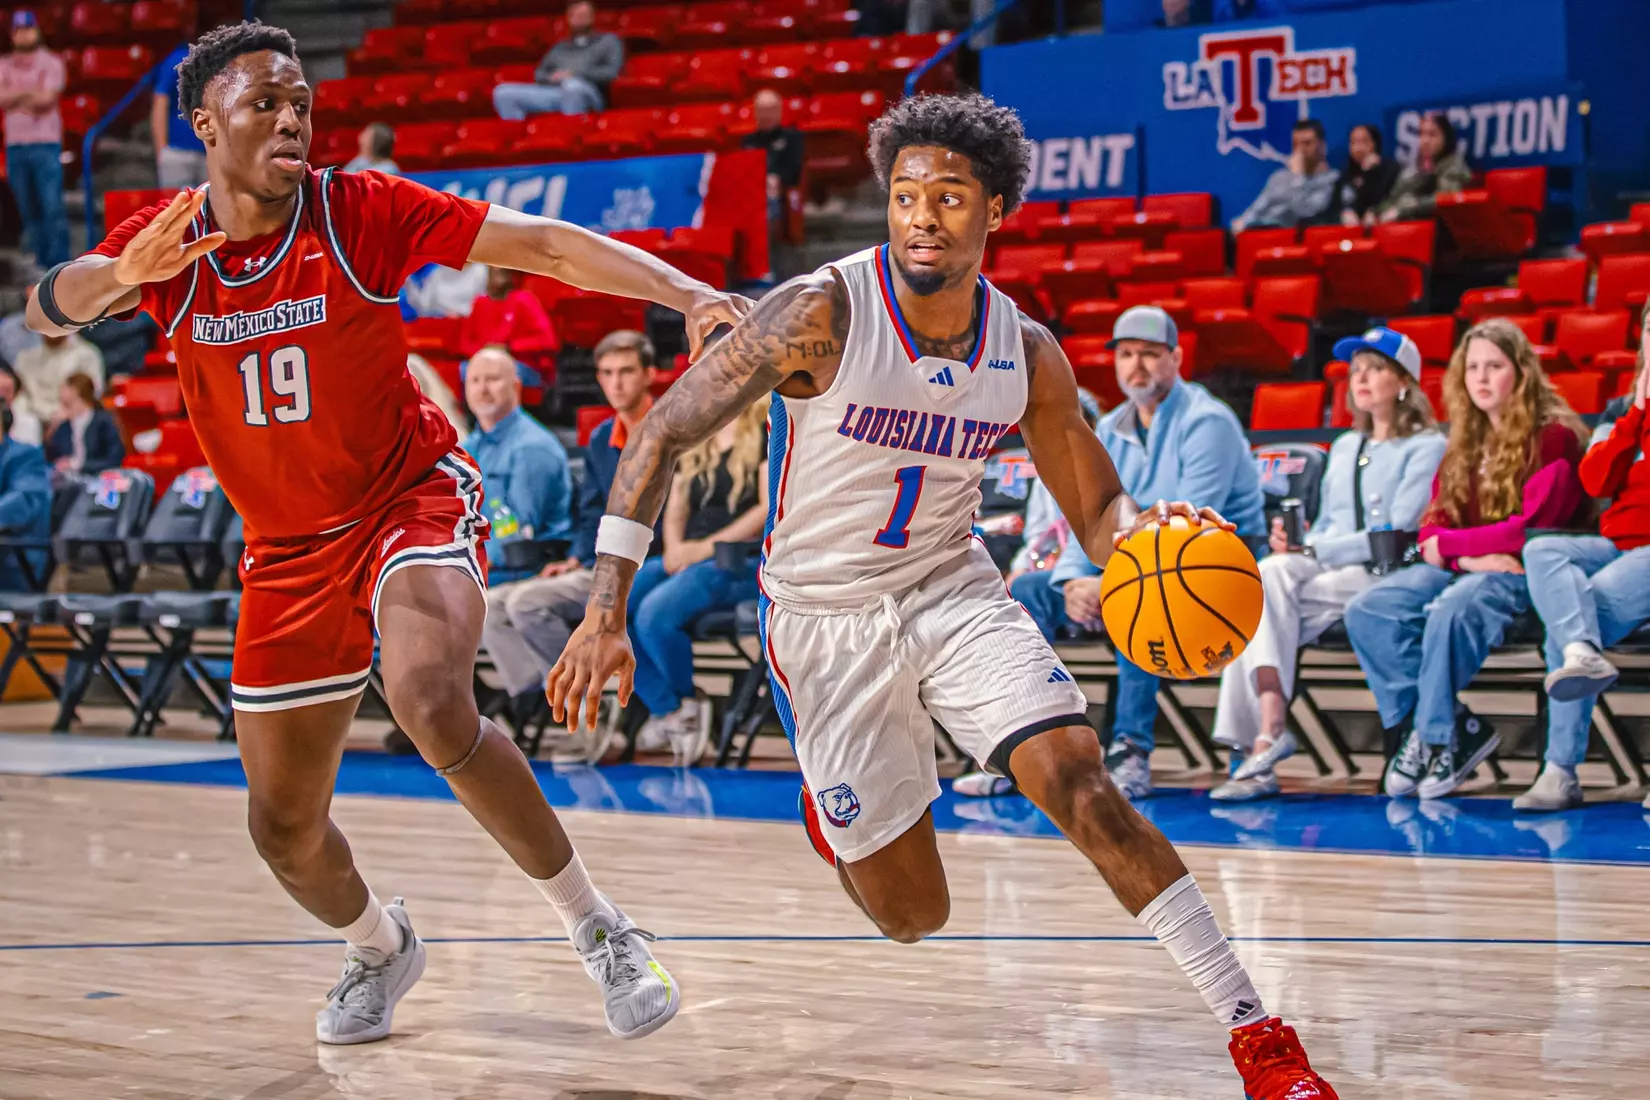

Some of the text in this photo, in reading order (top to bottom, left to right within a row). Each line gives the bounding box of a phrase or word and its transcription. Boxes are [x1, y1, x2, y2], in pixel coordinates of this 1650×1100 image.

[1203, 30, 1353, 127] TECH
[1395, 94, 1568, 172] SCTION
[194, 299, 321, 341] NEW MEXICO STATE
[238, 344, 312, 425] 19
[837, 402, 956, 457] LOUISIANA
[872, 465, 928, 549] 1
